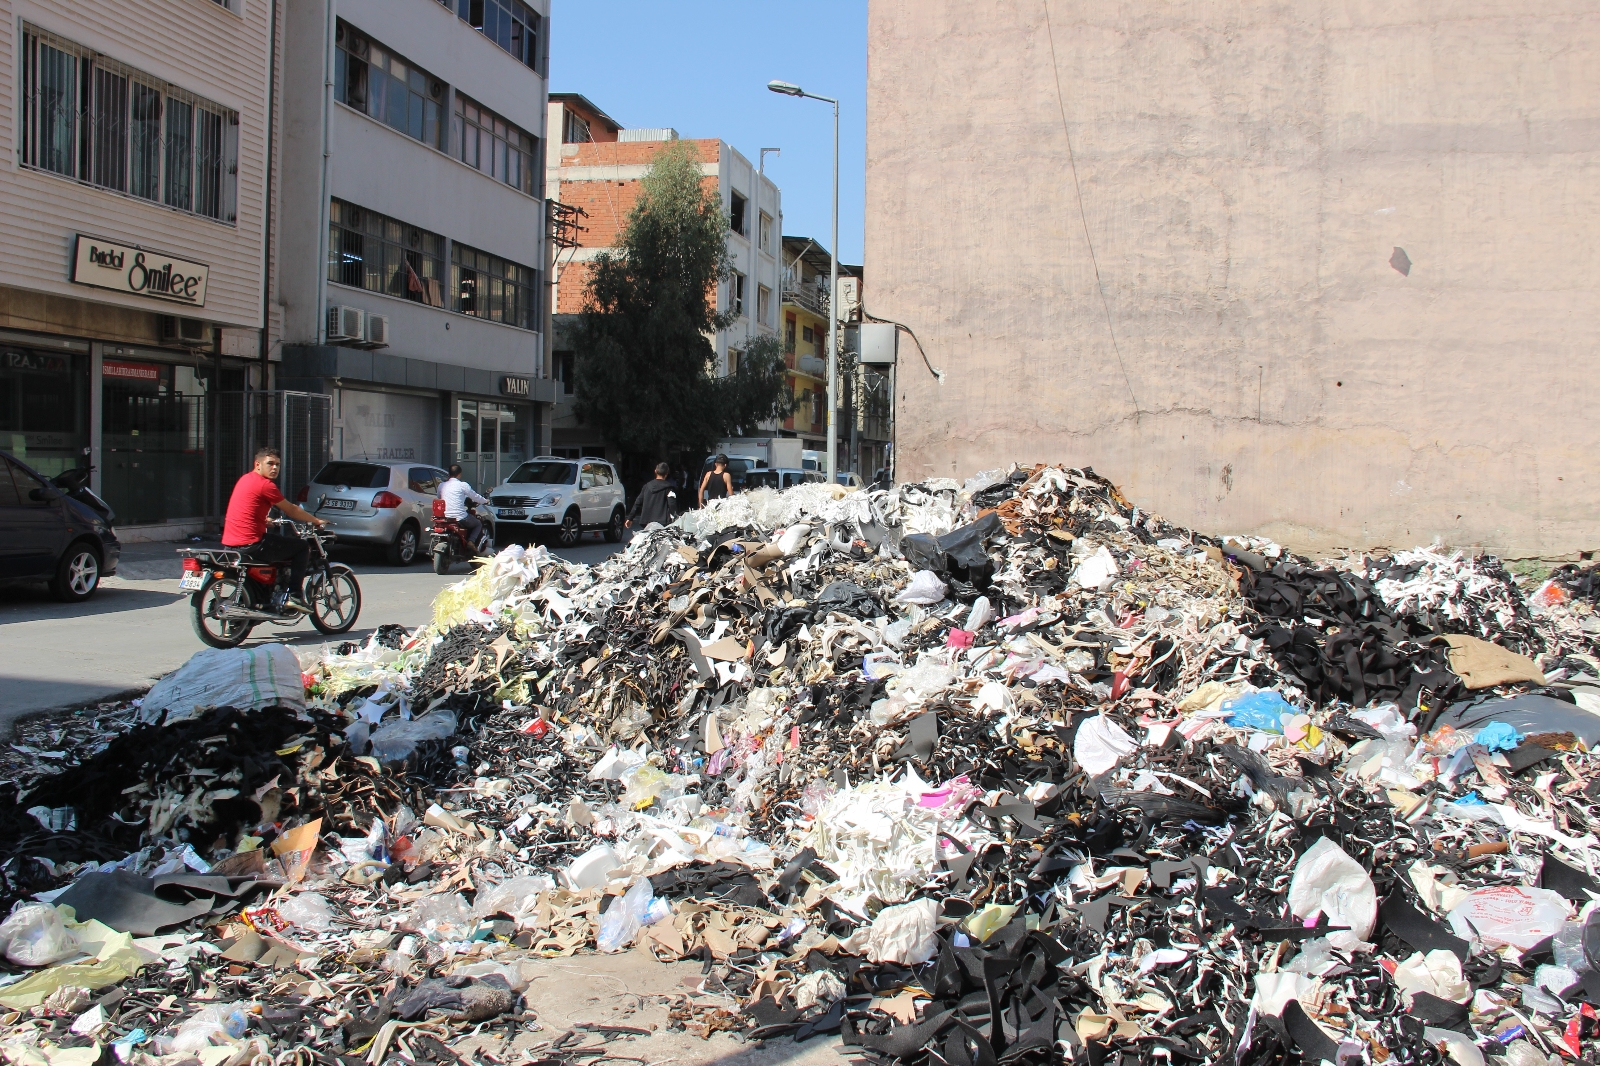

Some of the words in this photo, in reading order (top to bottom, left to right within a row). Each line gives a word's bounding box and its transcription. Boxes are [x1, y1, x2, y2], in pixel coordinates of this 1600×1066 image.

[128, 252, 199, 298] Smilee
[506, 377, 530, 396] YALIN
[377, 447, 415, 460] TRAILER
